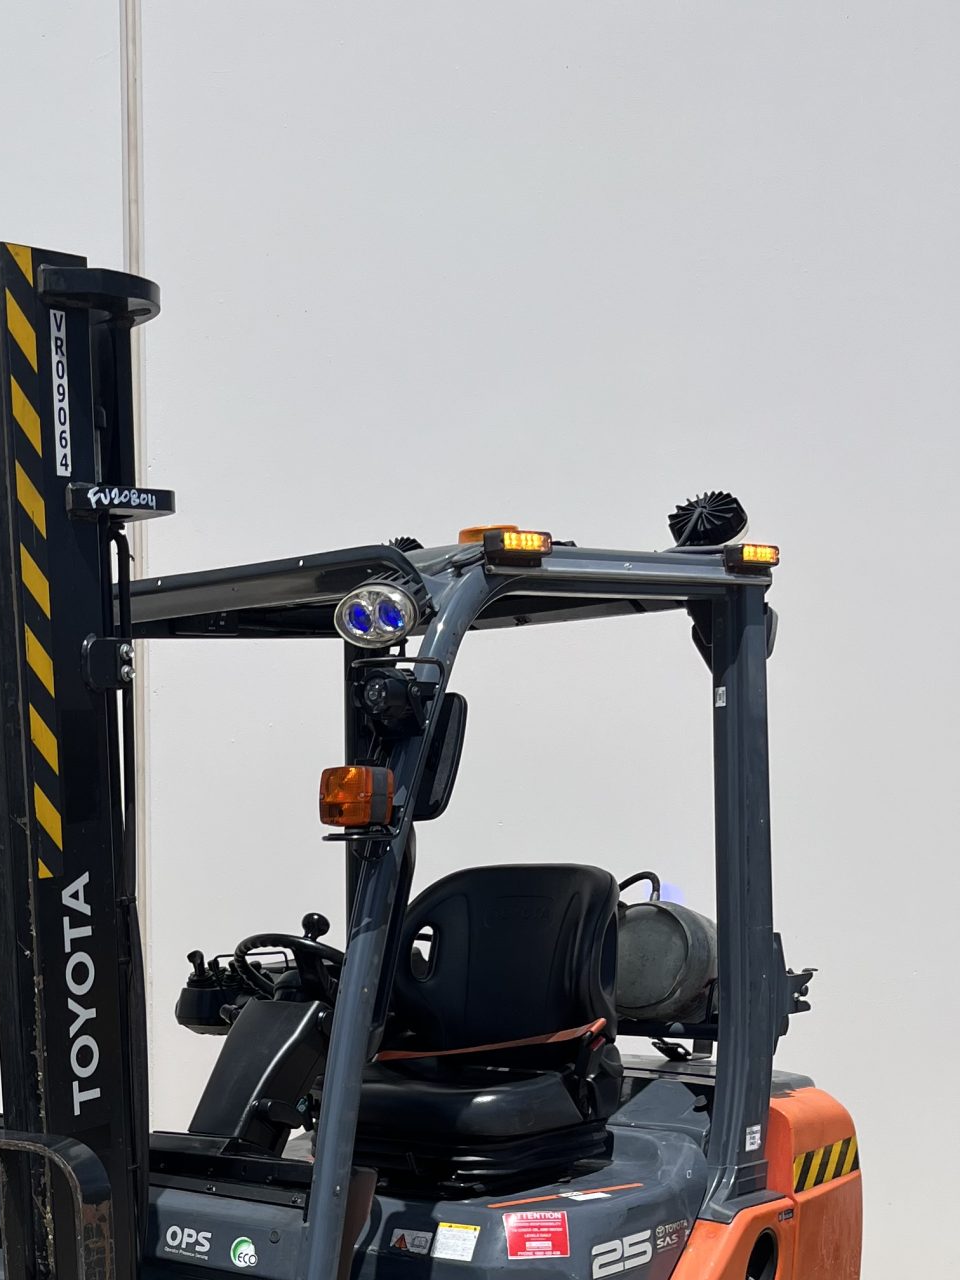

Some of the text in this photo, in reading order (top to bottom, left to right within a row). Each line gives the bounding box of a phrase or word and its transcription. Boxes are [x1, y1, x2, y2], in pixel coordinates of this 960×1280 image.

[53, 312, 70, 472] VR09064
[61, 870, 101, 1116] TOYOTA
[166, 1225, 212, 1252] OPS
[665, 1219, 688, 1233] TOYOTA
[591, 1229, 653, 1280] 25
[656, 1233, 678, 1249] SAS
[237, 1252, 257, 1265] ECO
